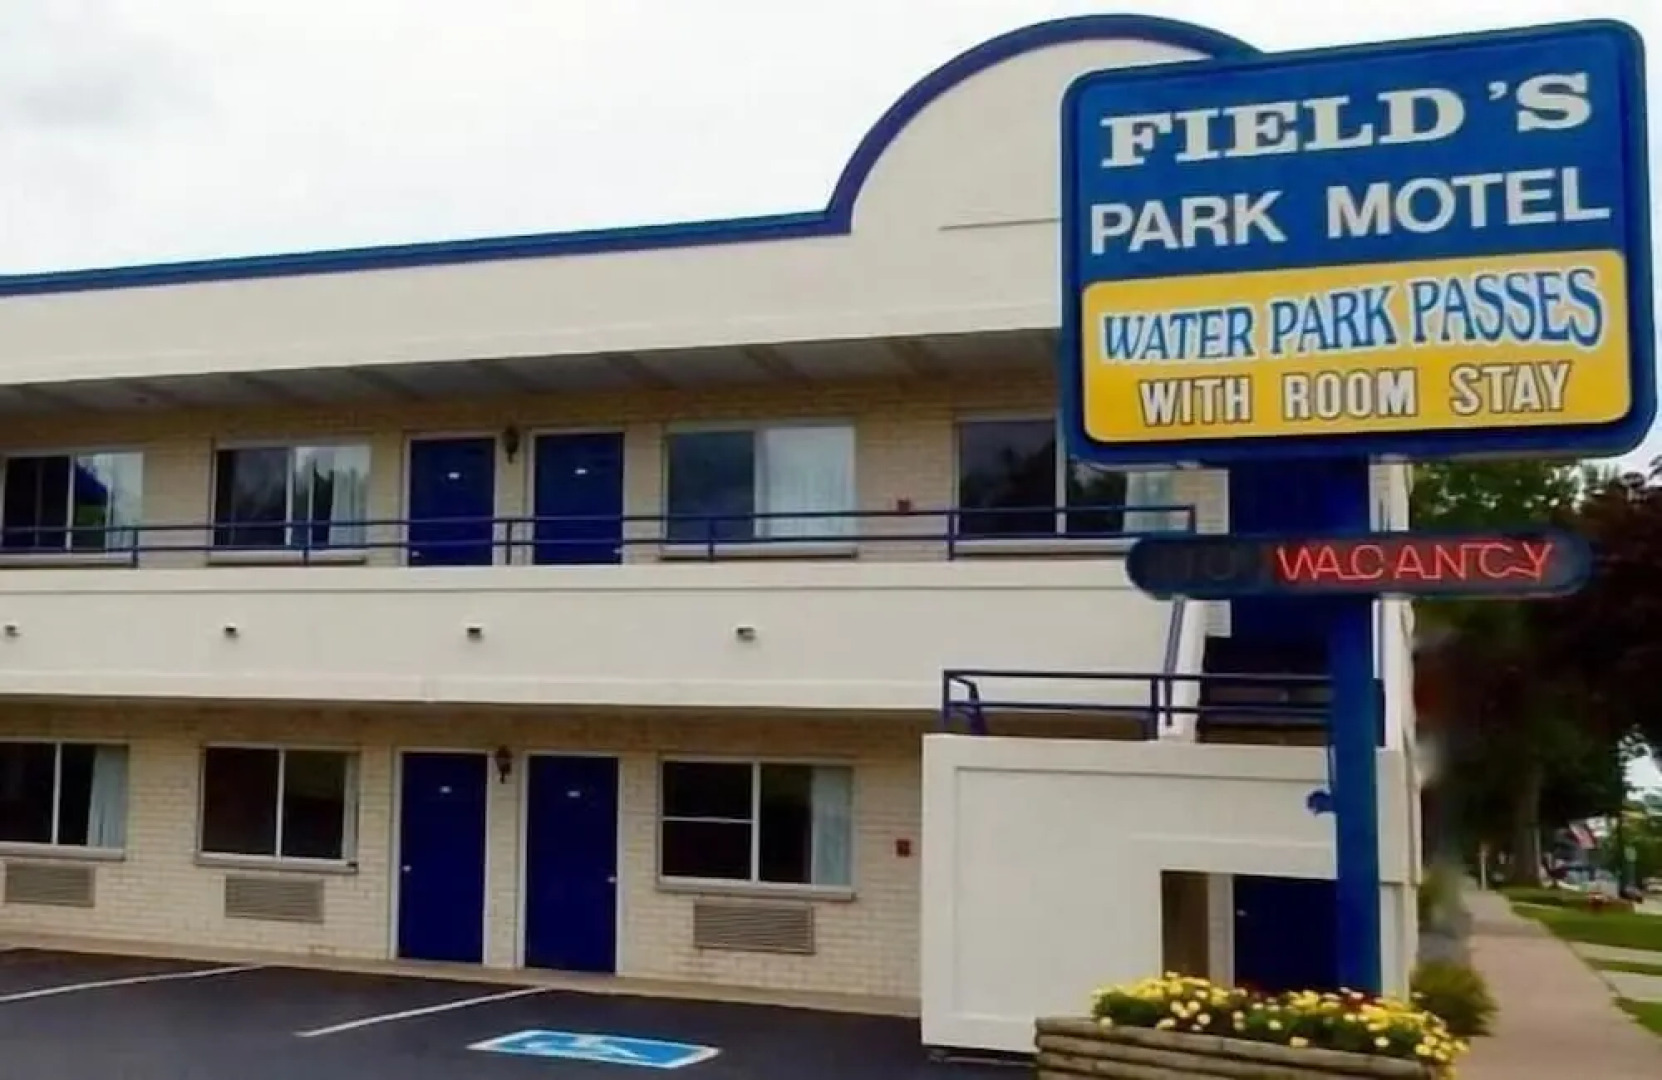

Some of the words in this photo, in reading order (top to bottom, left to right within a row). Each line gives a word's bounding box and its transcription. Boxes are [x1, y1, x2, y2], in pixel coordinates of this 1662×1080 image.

[1100, 72, 1592, 167] FIELD'S
[1091, 191, 1287, 254] PARK
[1327, 168, 1610, 238] MOTEL
[1103, 306, 1255, 361] WATER
[1271, 285, 1396, 355] PARK
[1411, 268, 1603, 347] PASSES
[1139, 376, 1251, 426] WITH
[1283, 368, 1418, 419] ROOM
[1450, 362, 1570, 414] STAY
[1277, 543, 1553, 581] VACANCY
